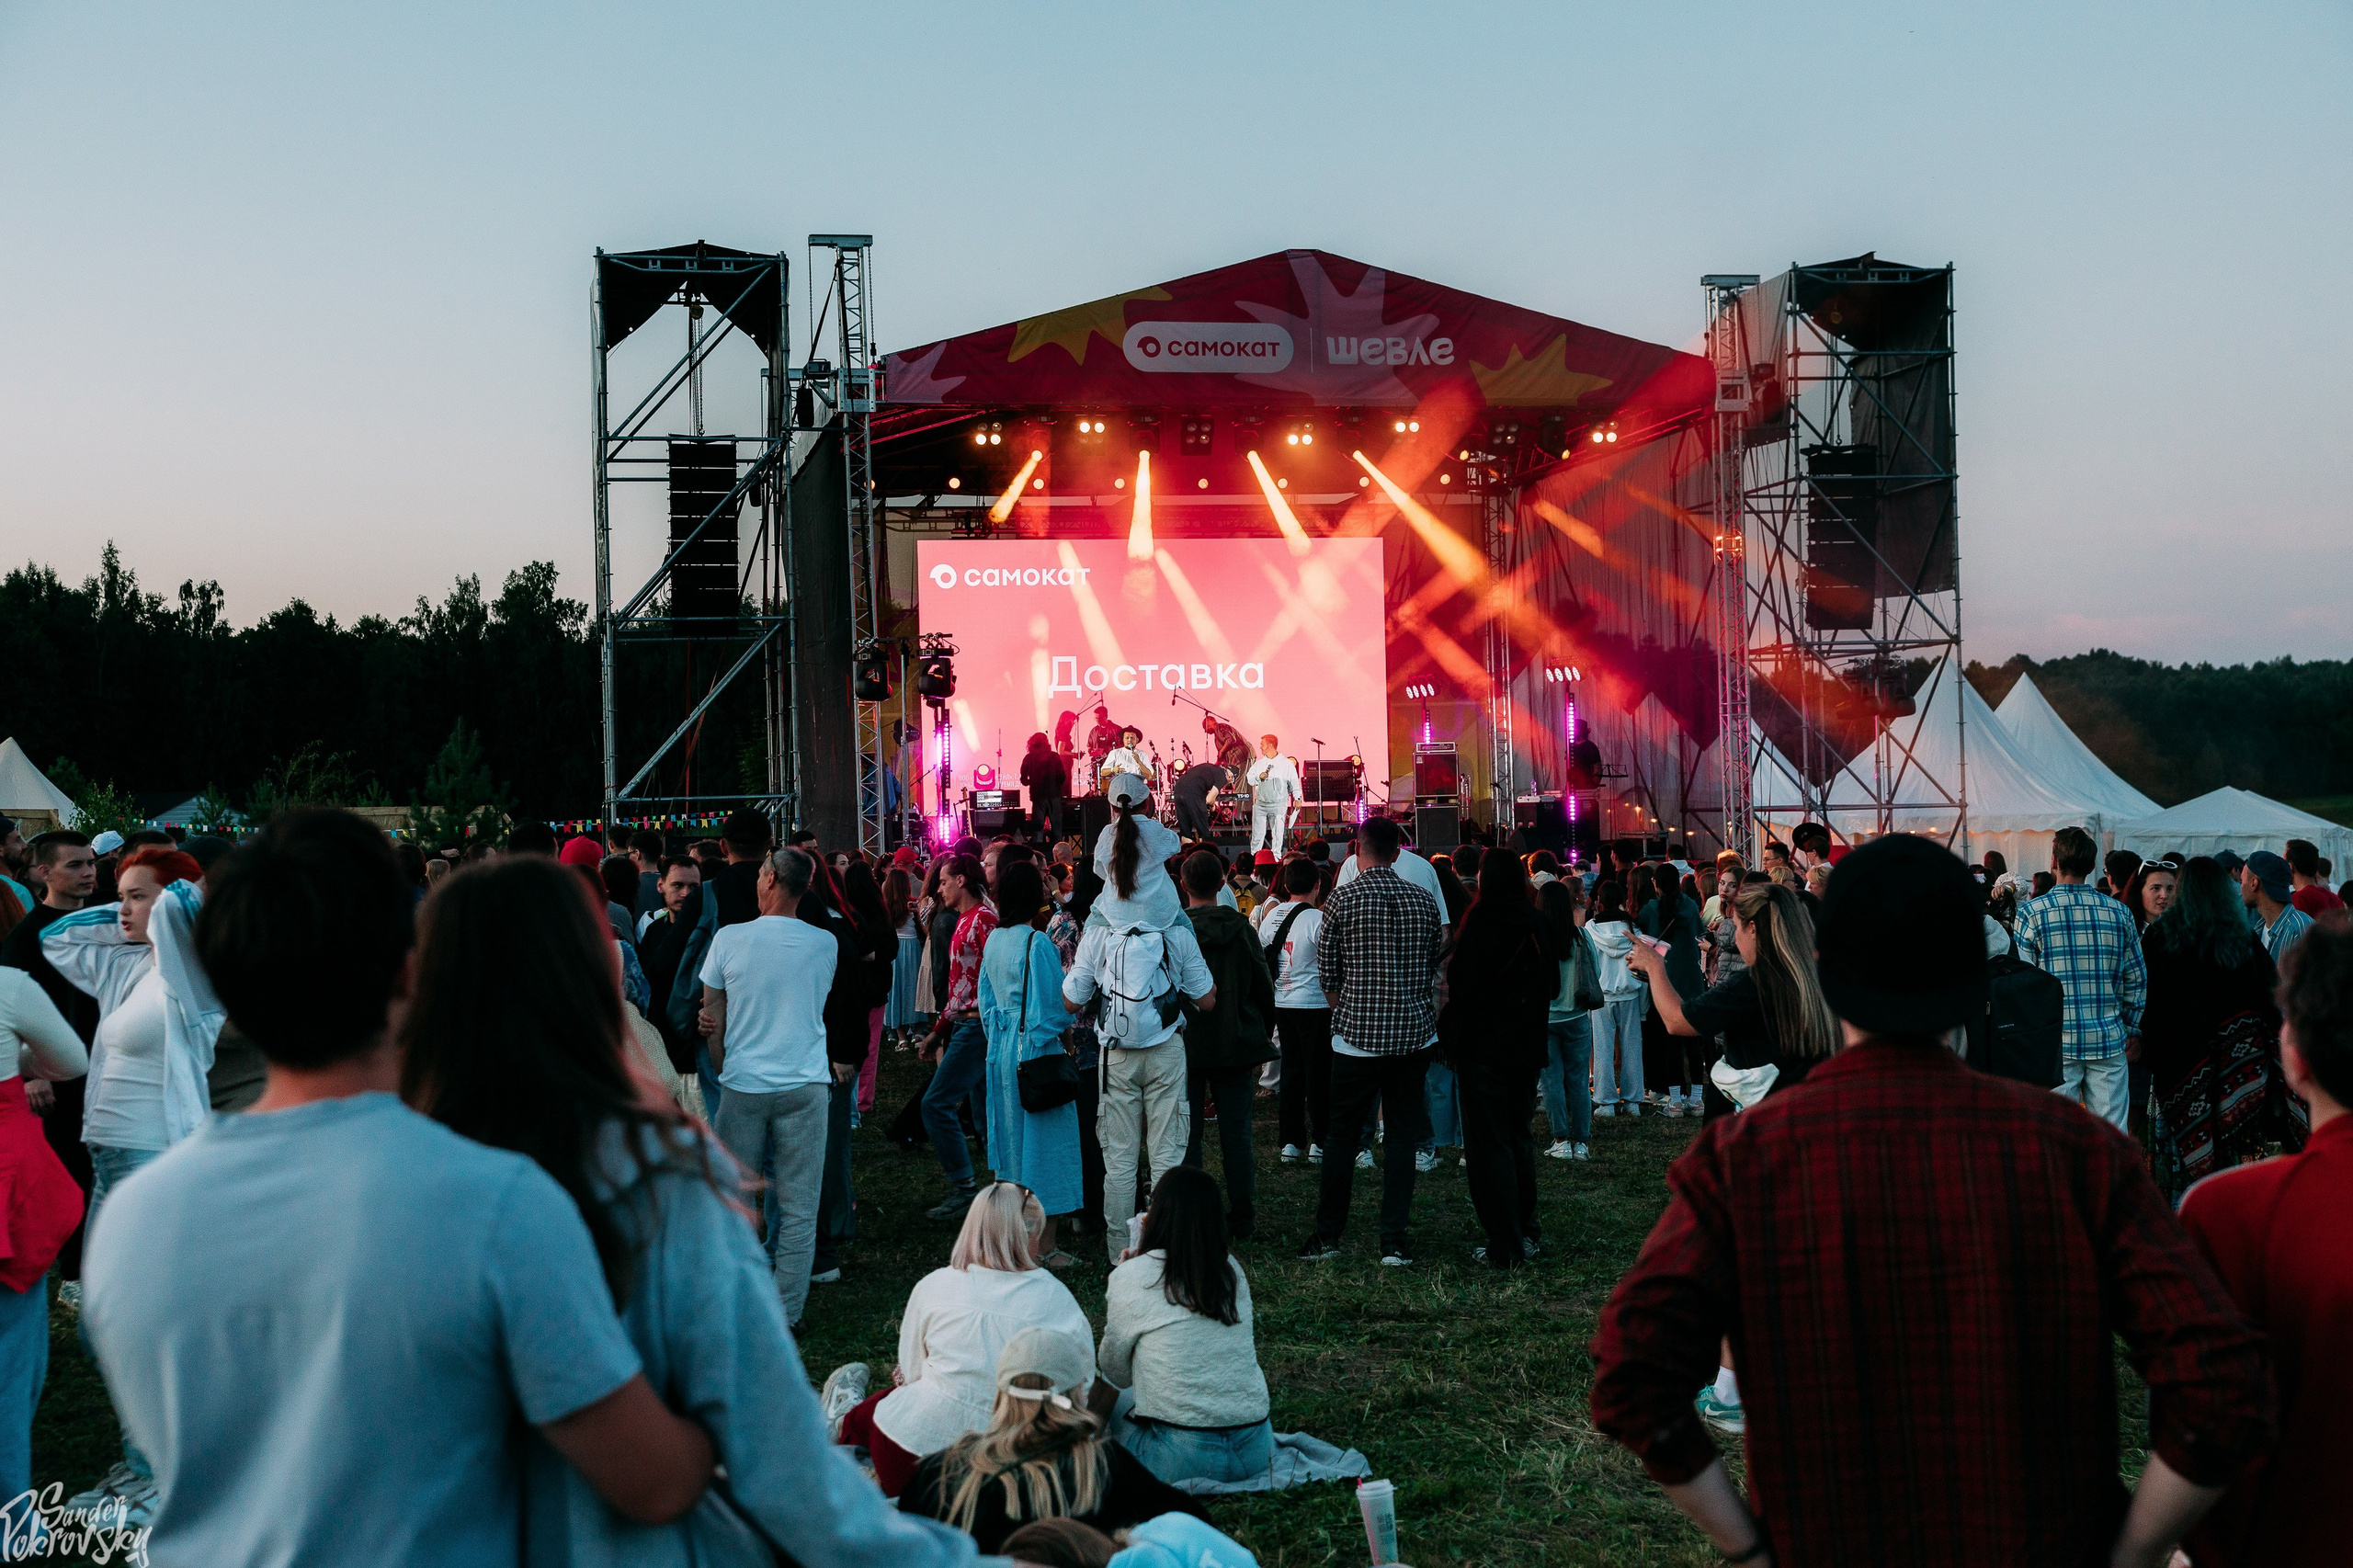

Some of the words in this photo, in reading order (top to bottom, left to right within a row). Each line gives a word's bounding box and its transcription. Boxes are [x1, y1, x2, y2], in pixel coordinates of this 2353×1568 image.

[1167, 340, 1280, 357] самокат
[963, 568, 1091, 586] самокат
[1048, 655, 1264, 699] Доставка
